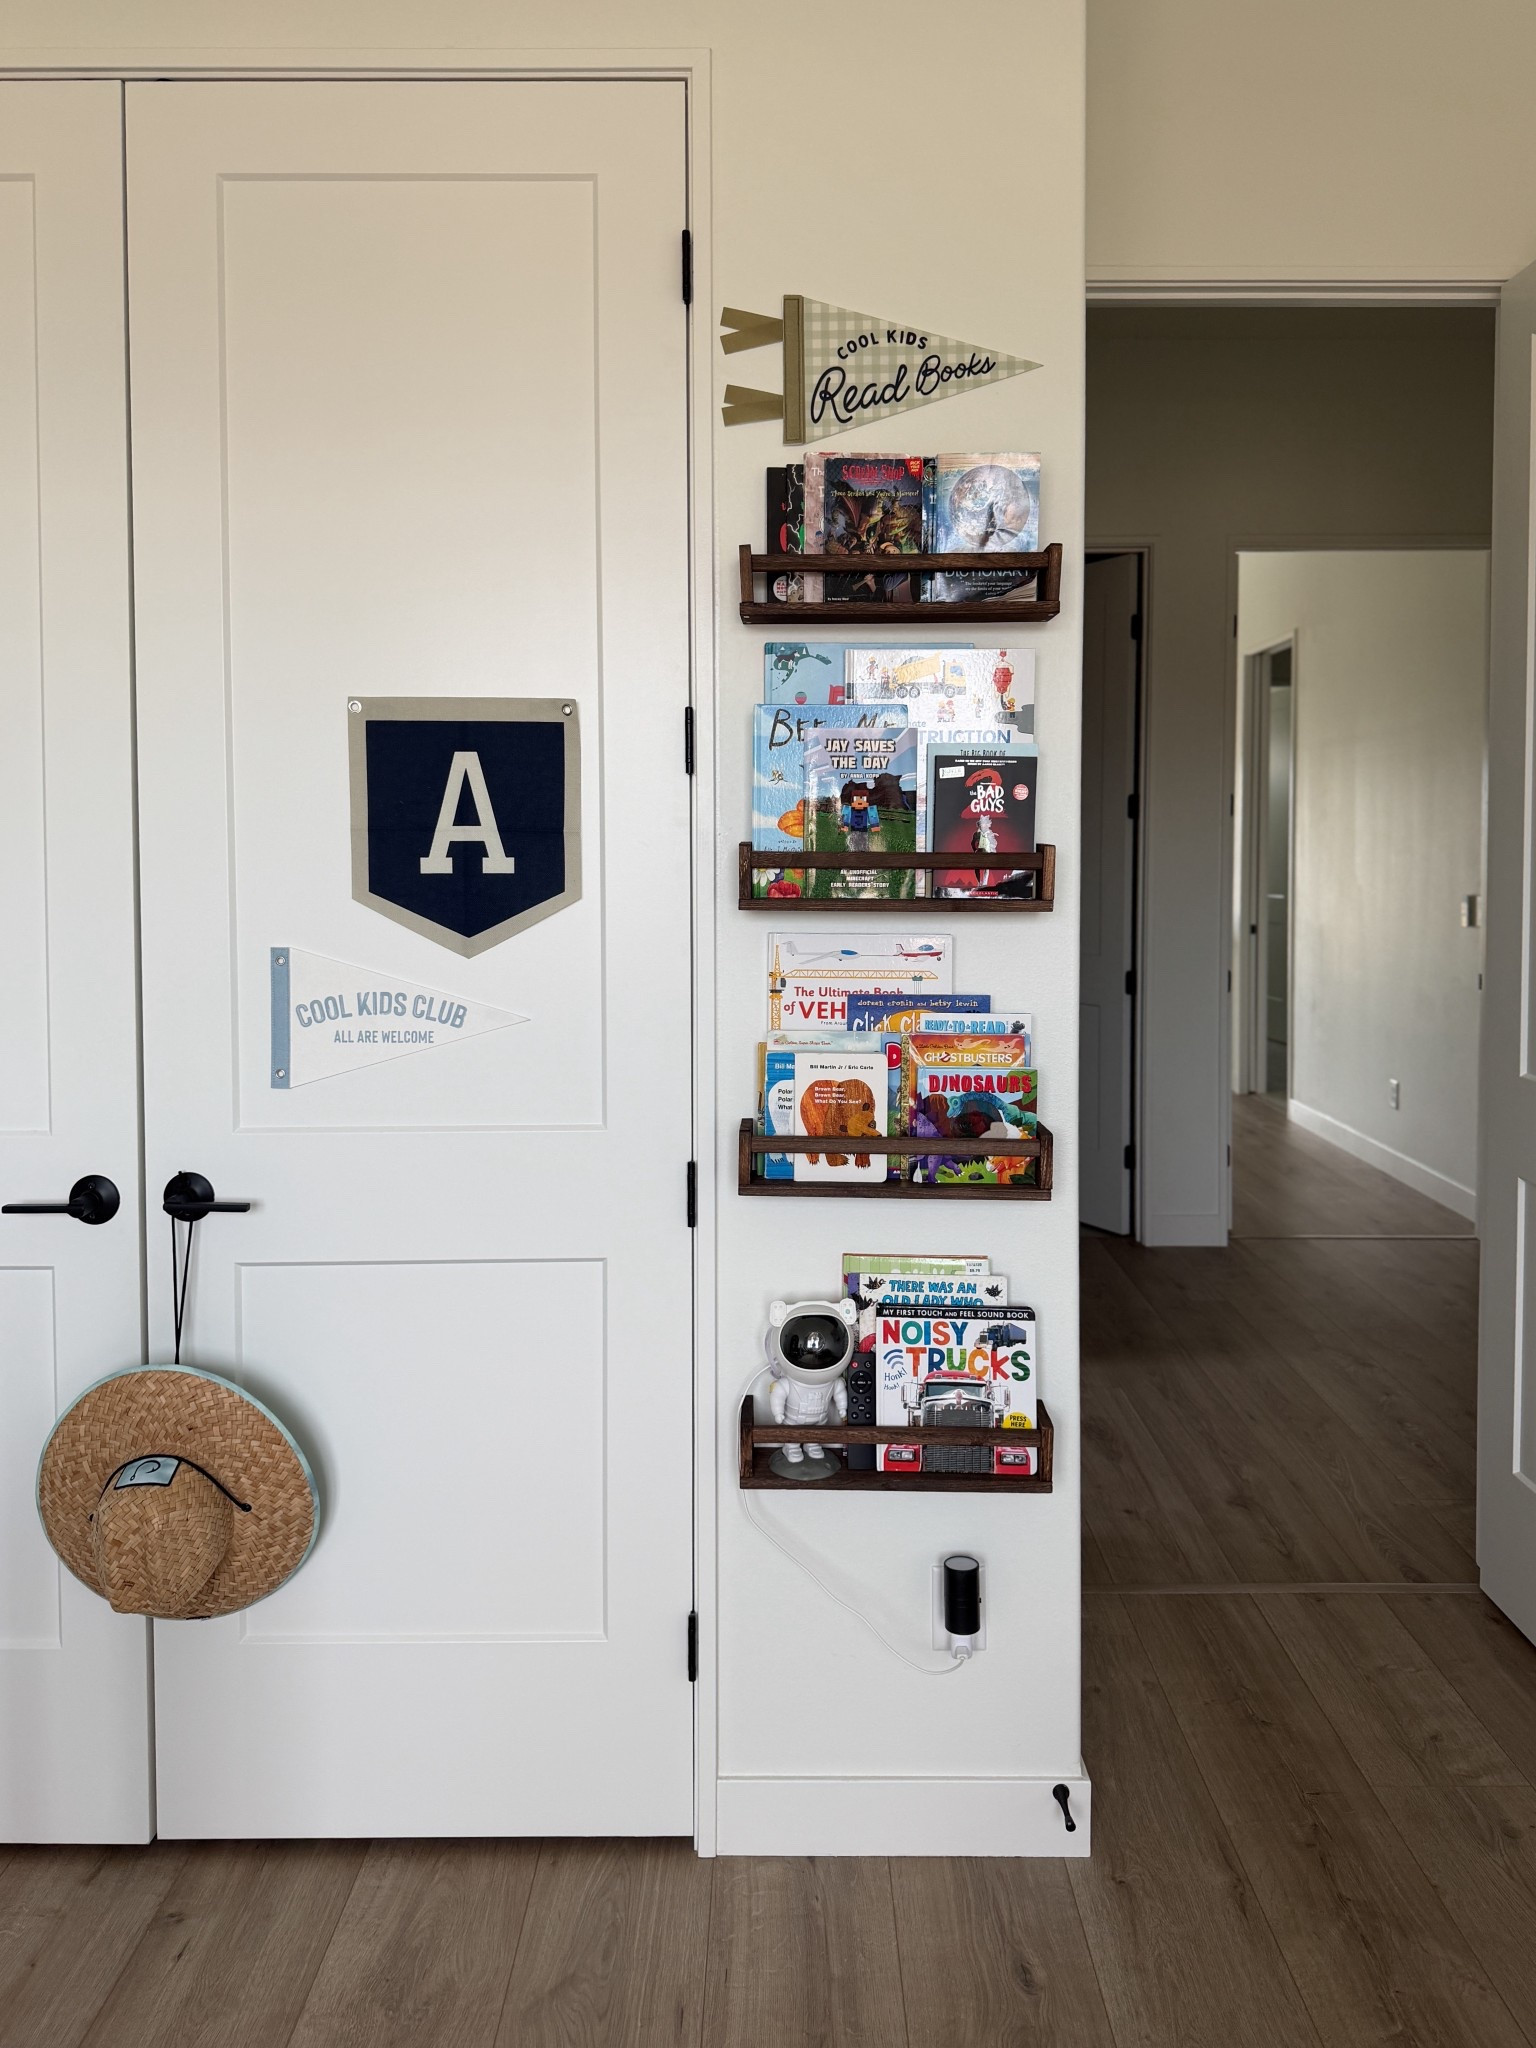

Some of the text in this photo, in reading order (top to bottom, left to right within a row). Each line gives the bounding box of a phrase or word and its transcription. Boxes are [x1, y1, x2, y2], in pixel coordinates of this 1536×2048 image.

[837, 329, 928, 359] COOL KIDS
[810, 353, 997, 424] Read Books
[881, 464, 905, 480] SHOP
[945, 570, 1029, 578] DICTIONARY
[825, 738, 896, 752] JAY SAVES
[831, 756, 890, 769] THE DAY
[976, 784, 1005, 799] BAD
[420, 751, 515, 874] A
[970, 799, 1005, 813] GUYS
[794, 986, 904, 997] The Ultimate Book
[295, 991, 468, 1029] COOL KIDS CLUB
[783, 1001, 846, 1019] of VEH
[887, 999, 914, 1007] cronin
[929, 999, 952, 1008] betsy
[955, 999, 979, 1007] lewin
[852, 1011, 894, 1032] Click
[924, 1019, 1006, 1034] READY TO READ
[333, 1030, 435, 1044] ALL ARE WELCOME
[928, 1074, 1032, 1093] DINOSAURS
[889, 1279, 977, 1294] THERE WAS AN
[881, 1294, 984, 1306] OLD LADY WHO
[917, 1309, 943, 1317] TOUCH
[1007, 1311, 1029, 1319] BOOK
[882, 1319, 969, 1346] NOISY
[905, 1346, 1031, 1382] TRUCKS
[884, 1366, 908, 1382] Honk!
[1009, 1414, 1027, 1422] PRESS
